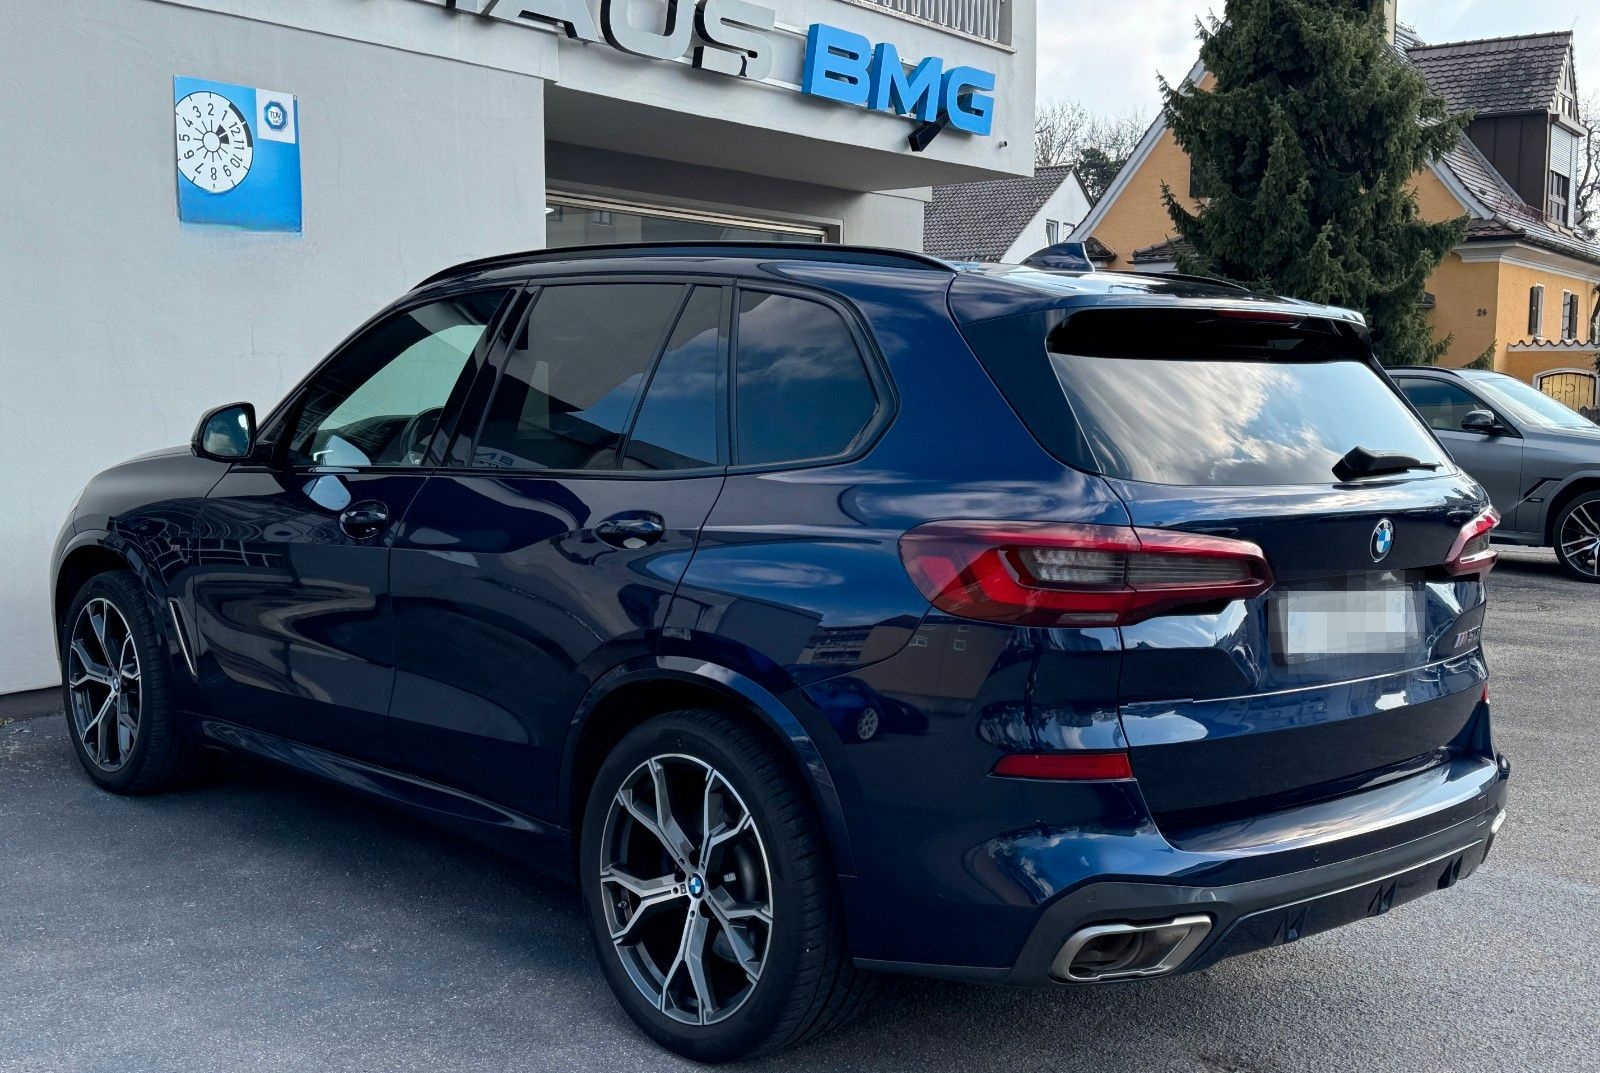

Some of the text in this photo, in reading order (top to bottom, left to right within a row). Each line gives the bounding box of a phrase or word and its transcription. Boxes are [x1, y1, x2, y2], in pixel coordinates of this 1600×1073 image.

[802, 23, 996, 137] BMG
[192, 105, 202, 118] 3
[207, 103, 214, 116] 2
[222, 110, 228, 121] 1
[182, 116, 194, 127] 4
[229, 122, 241, 137] 12
[179, 134, 191, 142] 5
[234, 139, 245, 151] 11
[184, 150, 195, 160] 6
[229, 154, 243, 169] 10
[194, 162, 204, 174] 7
[210, 167, 217, 180] 8
[223, 165, 232, 177] 9
